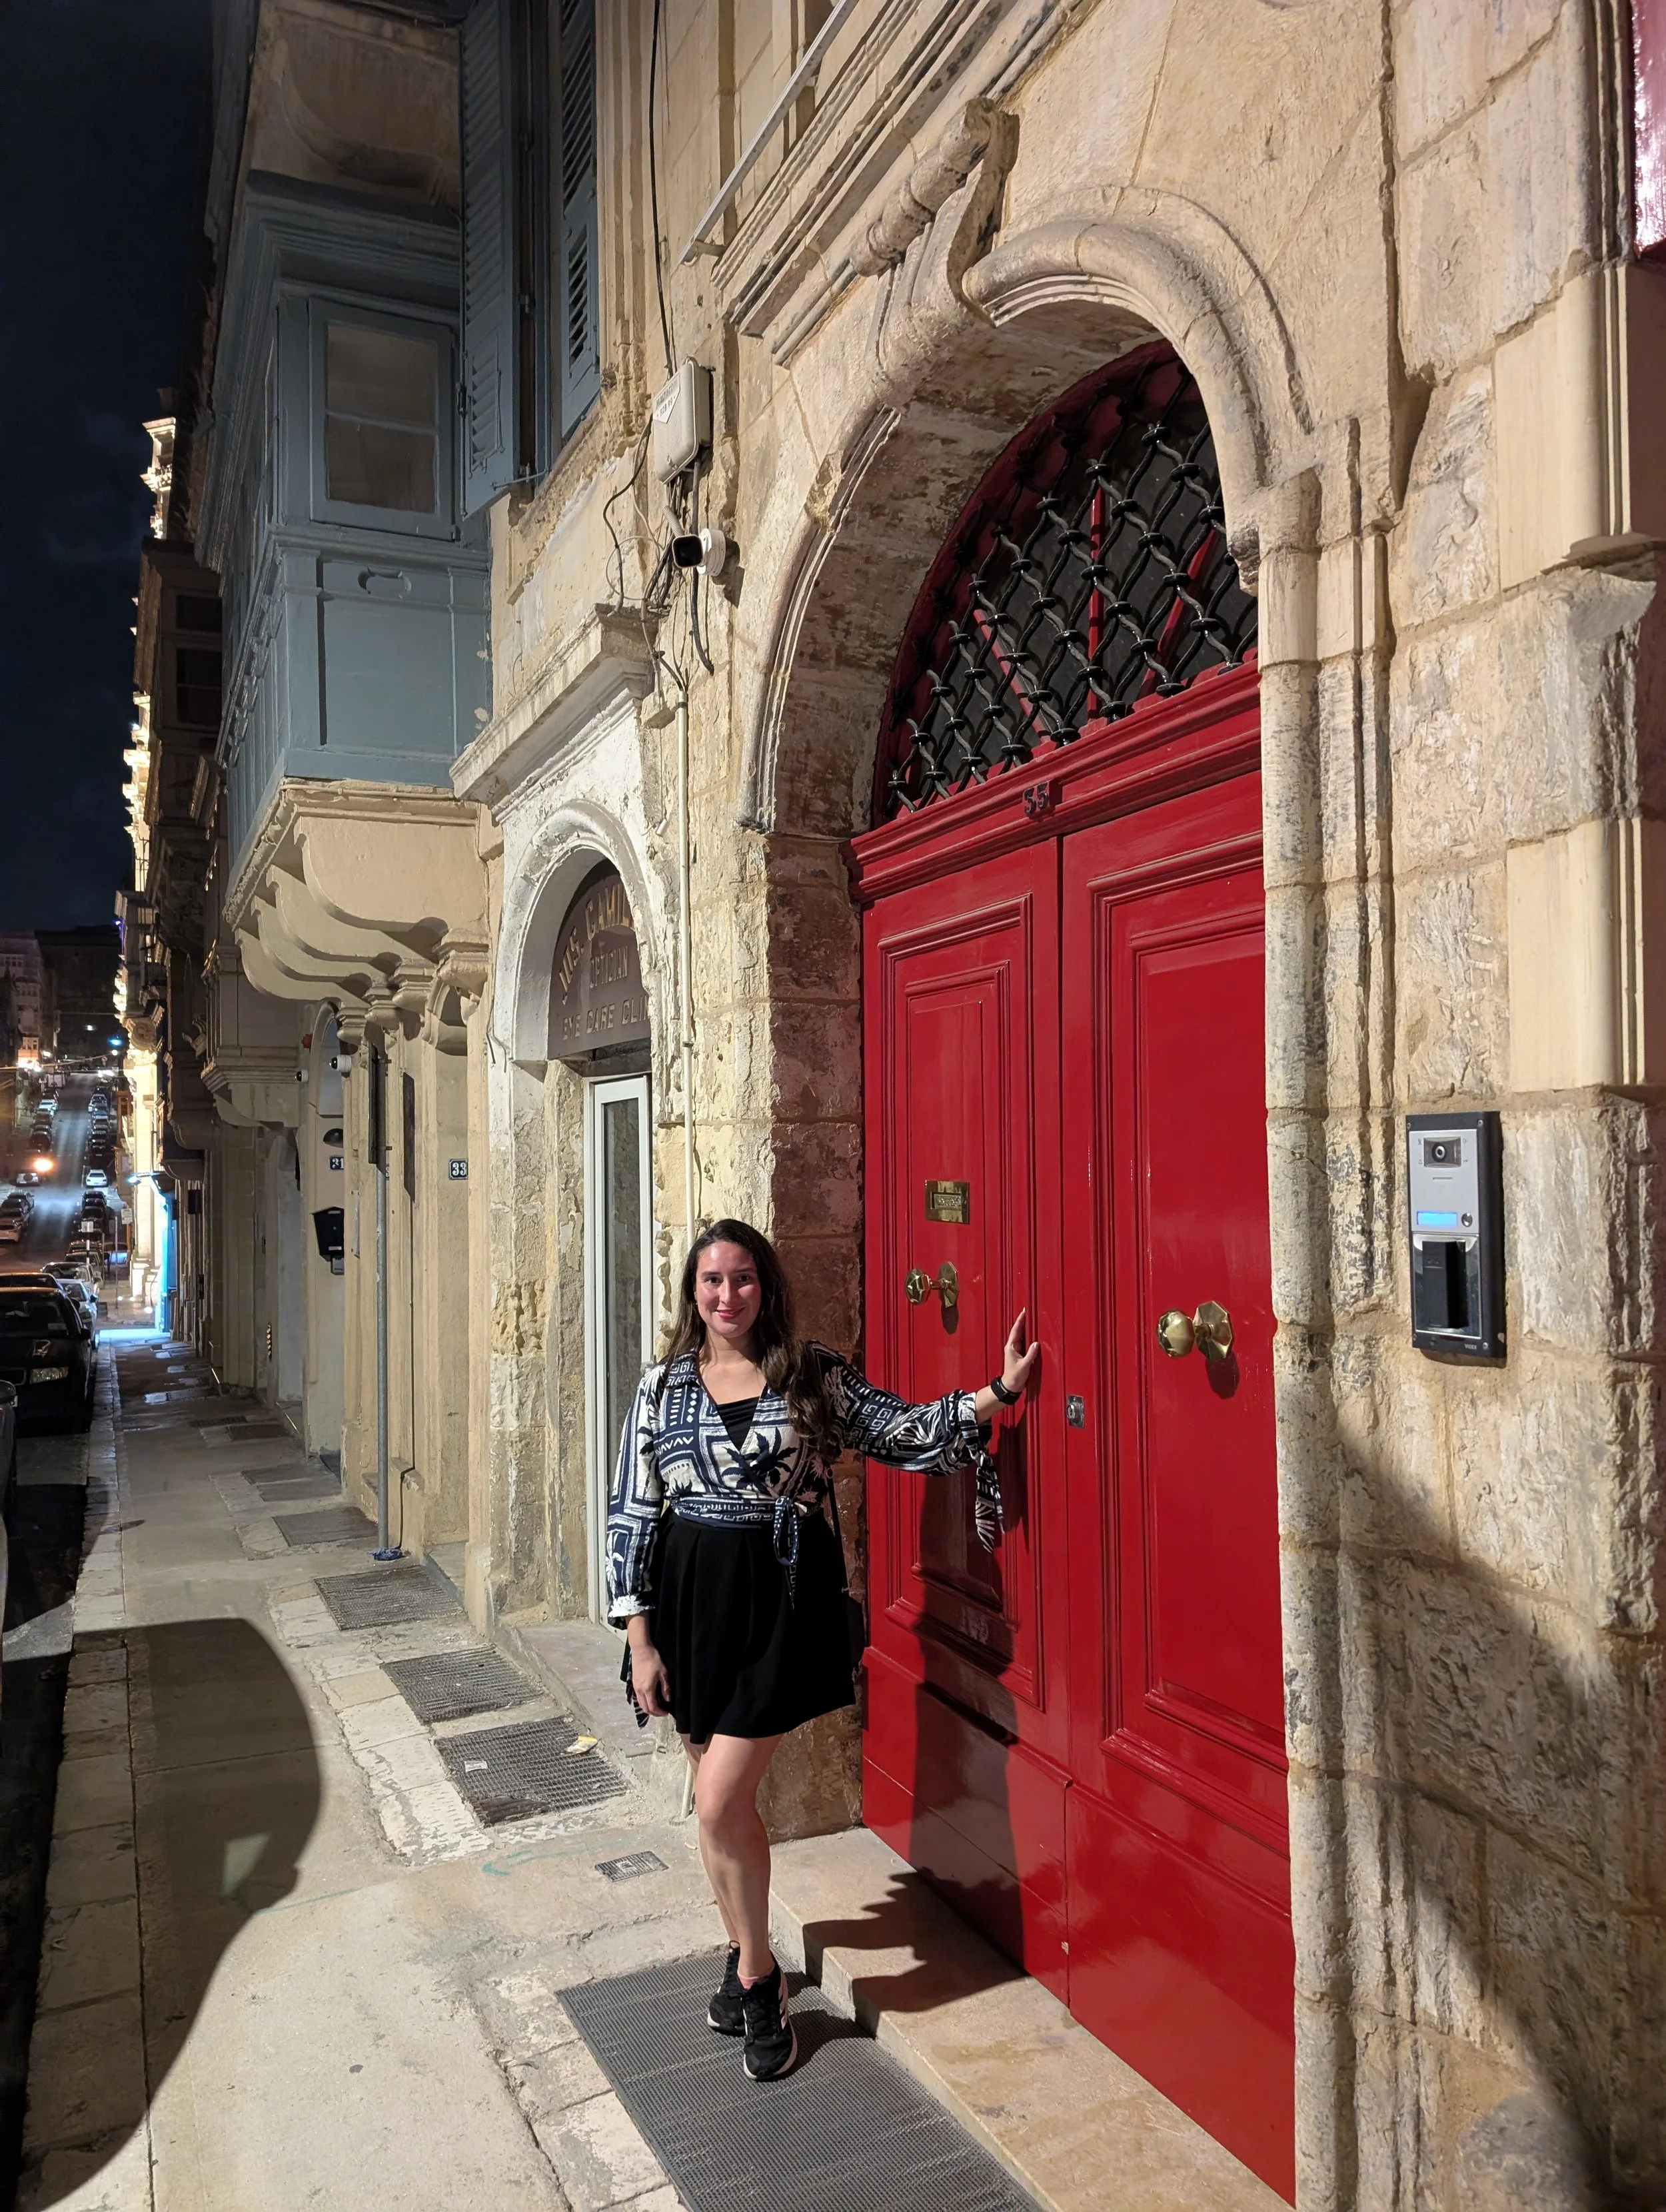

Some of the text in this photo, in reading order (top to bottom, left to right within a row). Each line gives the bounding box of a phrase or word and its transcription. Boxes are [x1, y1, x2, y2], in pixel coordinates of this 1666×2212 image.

[1024, 782, 1048, 815] 55
[590, 945, 628, 989] OPTICIAN
[562, 1013, 581, 1041] EYE
[586, 1003, 615, 1034] CARE
[332, 1157, 344, 1169] 31
[452, 1162, 466, 1176] 33
